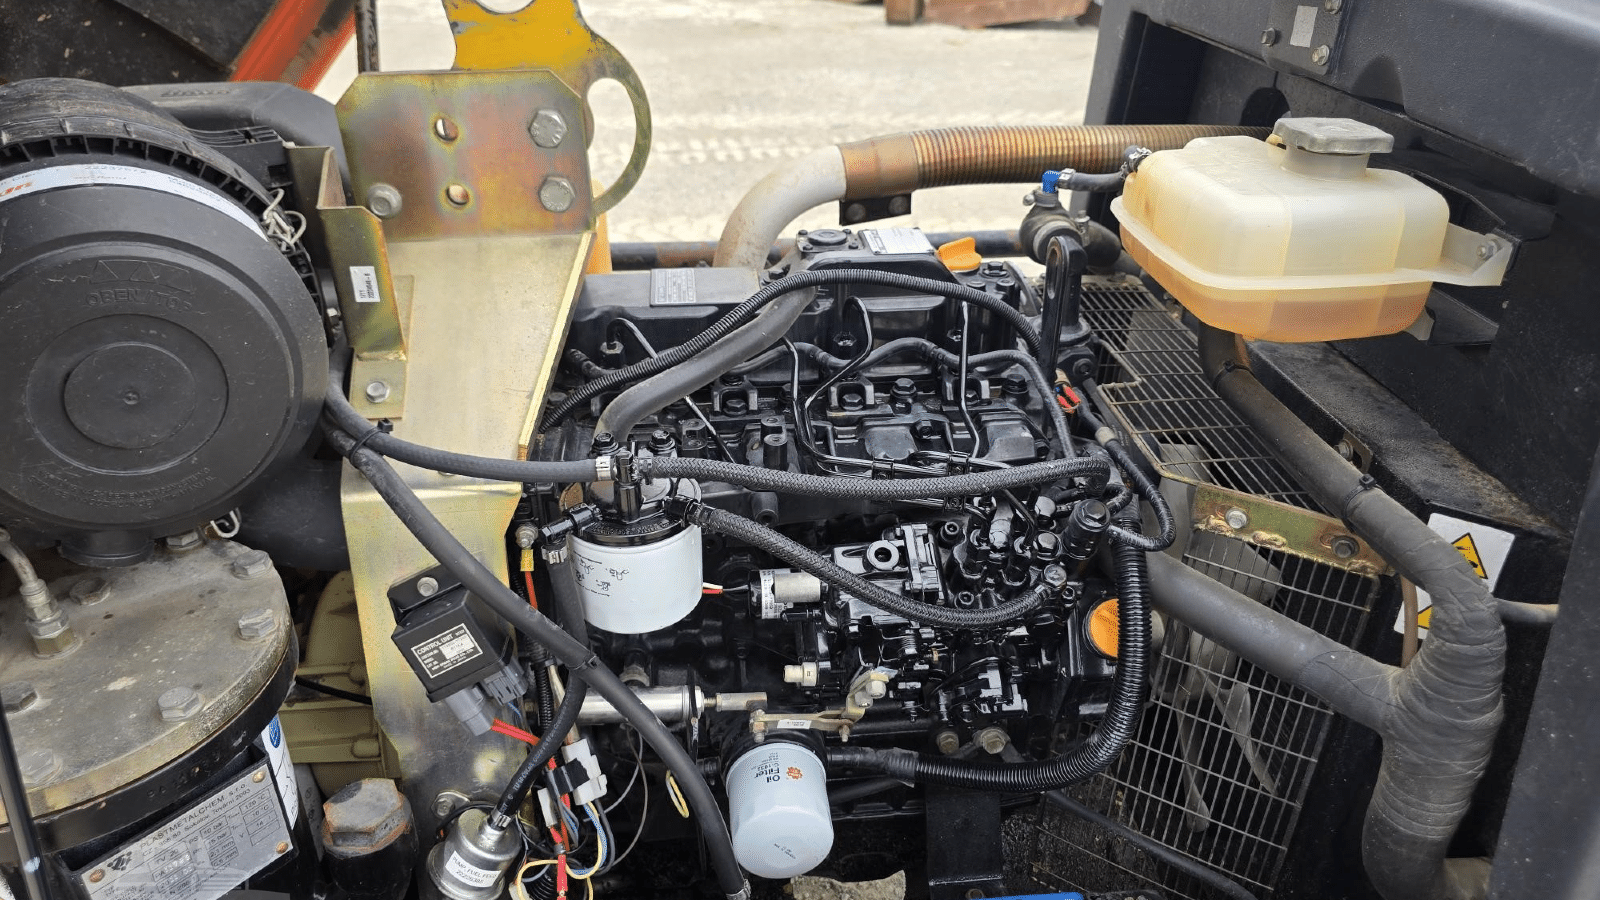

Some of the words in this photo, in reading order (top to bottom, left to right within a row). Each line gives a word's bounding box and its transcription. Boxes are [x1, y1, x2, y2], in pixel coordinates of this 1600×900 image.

[416, 640, 442, 655] CONTROL
[753, 767, 780, 779] Filter
[766, 774, 780, 783] Oil
[139, 795, 225, 849] PLASTMETALCHEM
[467, 869, 480, 877] FUEL
